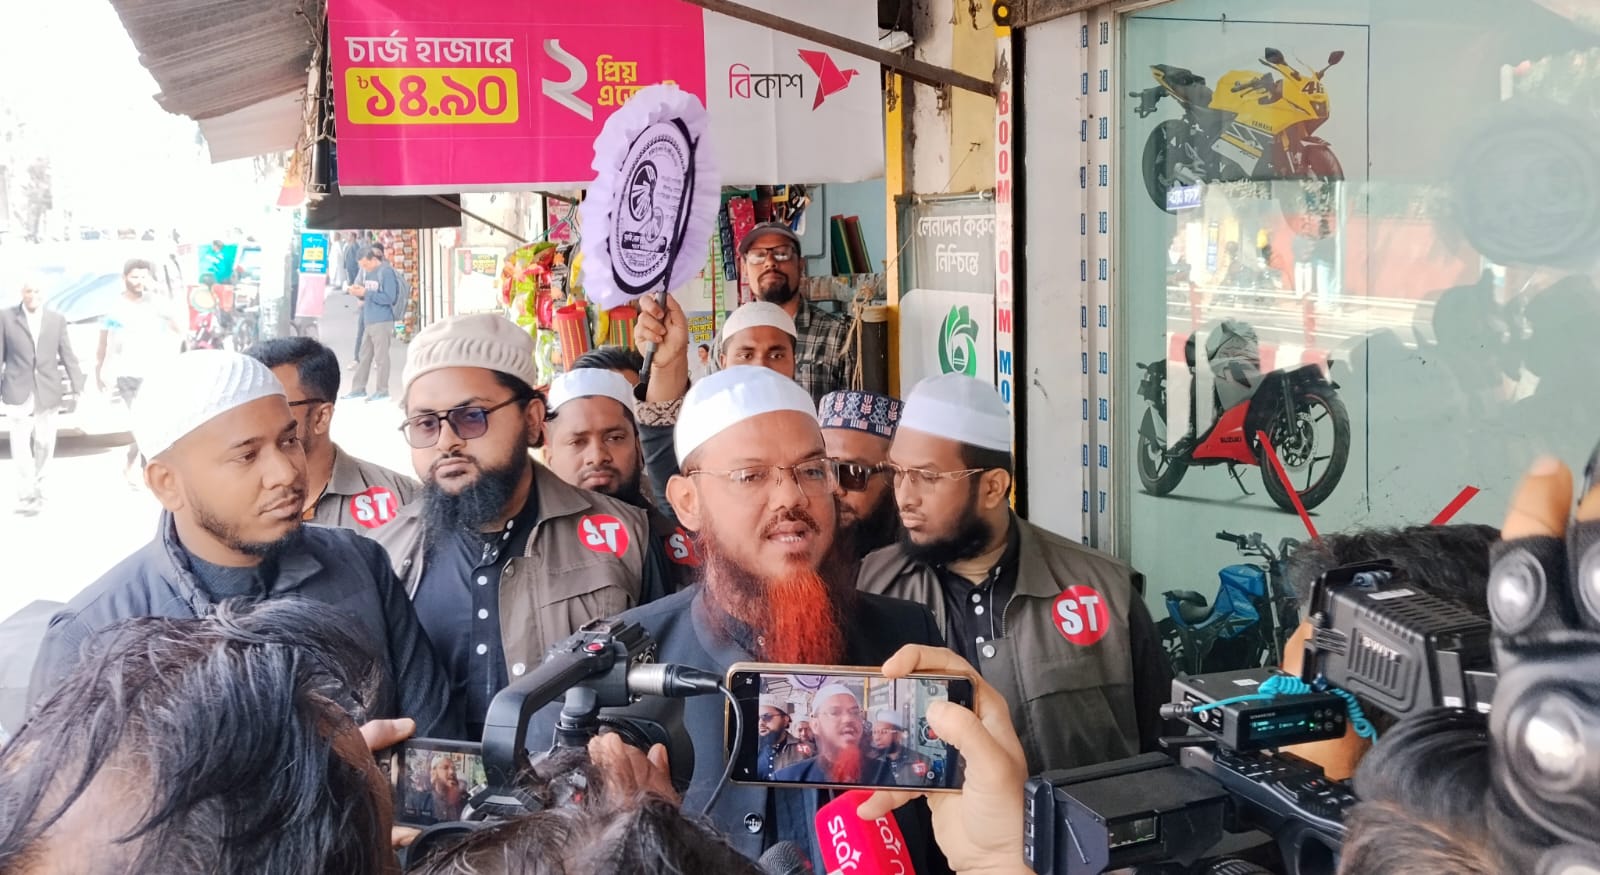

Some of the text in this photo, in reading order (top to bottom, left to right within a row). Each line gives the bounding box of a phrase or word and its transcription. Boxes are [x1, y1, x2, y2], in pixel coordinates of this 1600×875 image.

[344, 30, 514, 64] চার্জ হাজারে
[541, 39, 594, 121] ২
[595, 54, 638, 84] প্রিয়
[729, 63, 803, 99] বিকাশ
[997, 91, 1010, 203] BOOM
[917, 215, 962, 238] লেনদেন
[999, 350, 1012, 407] MO
[354, 491, 391, 521] ST
[582, 518, 620, 553] ST
[669, 533, 689, 559] S
[1056, 595, 1100, 635] ST
[876, 816, 902, 855] tar
